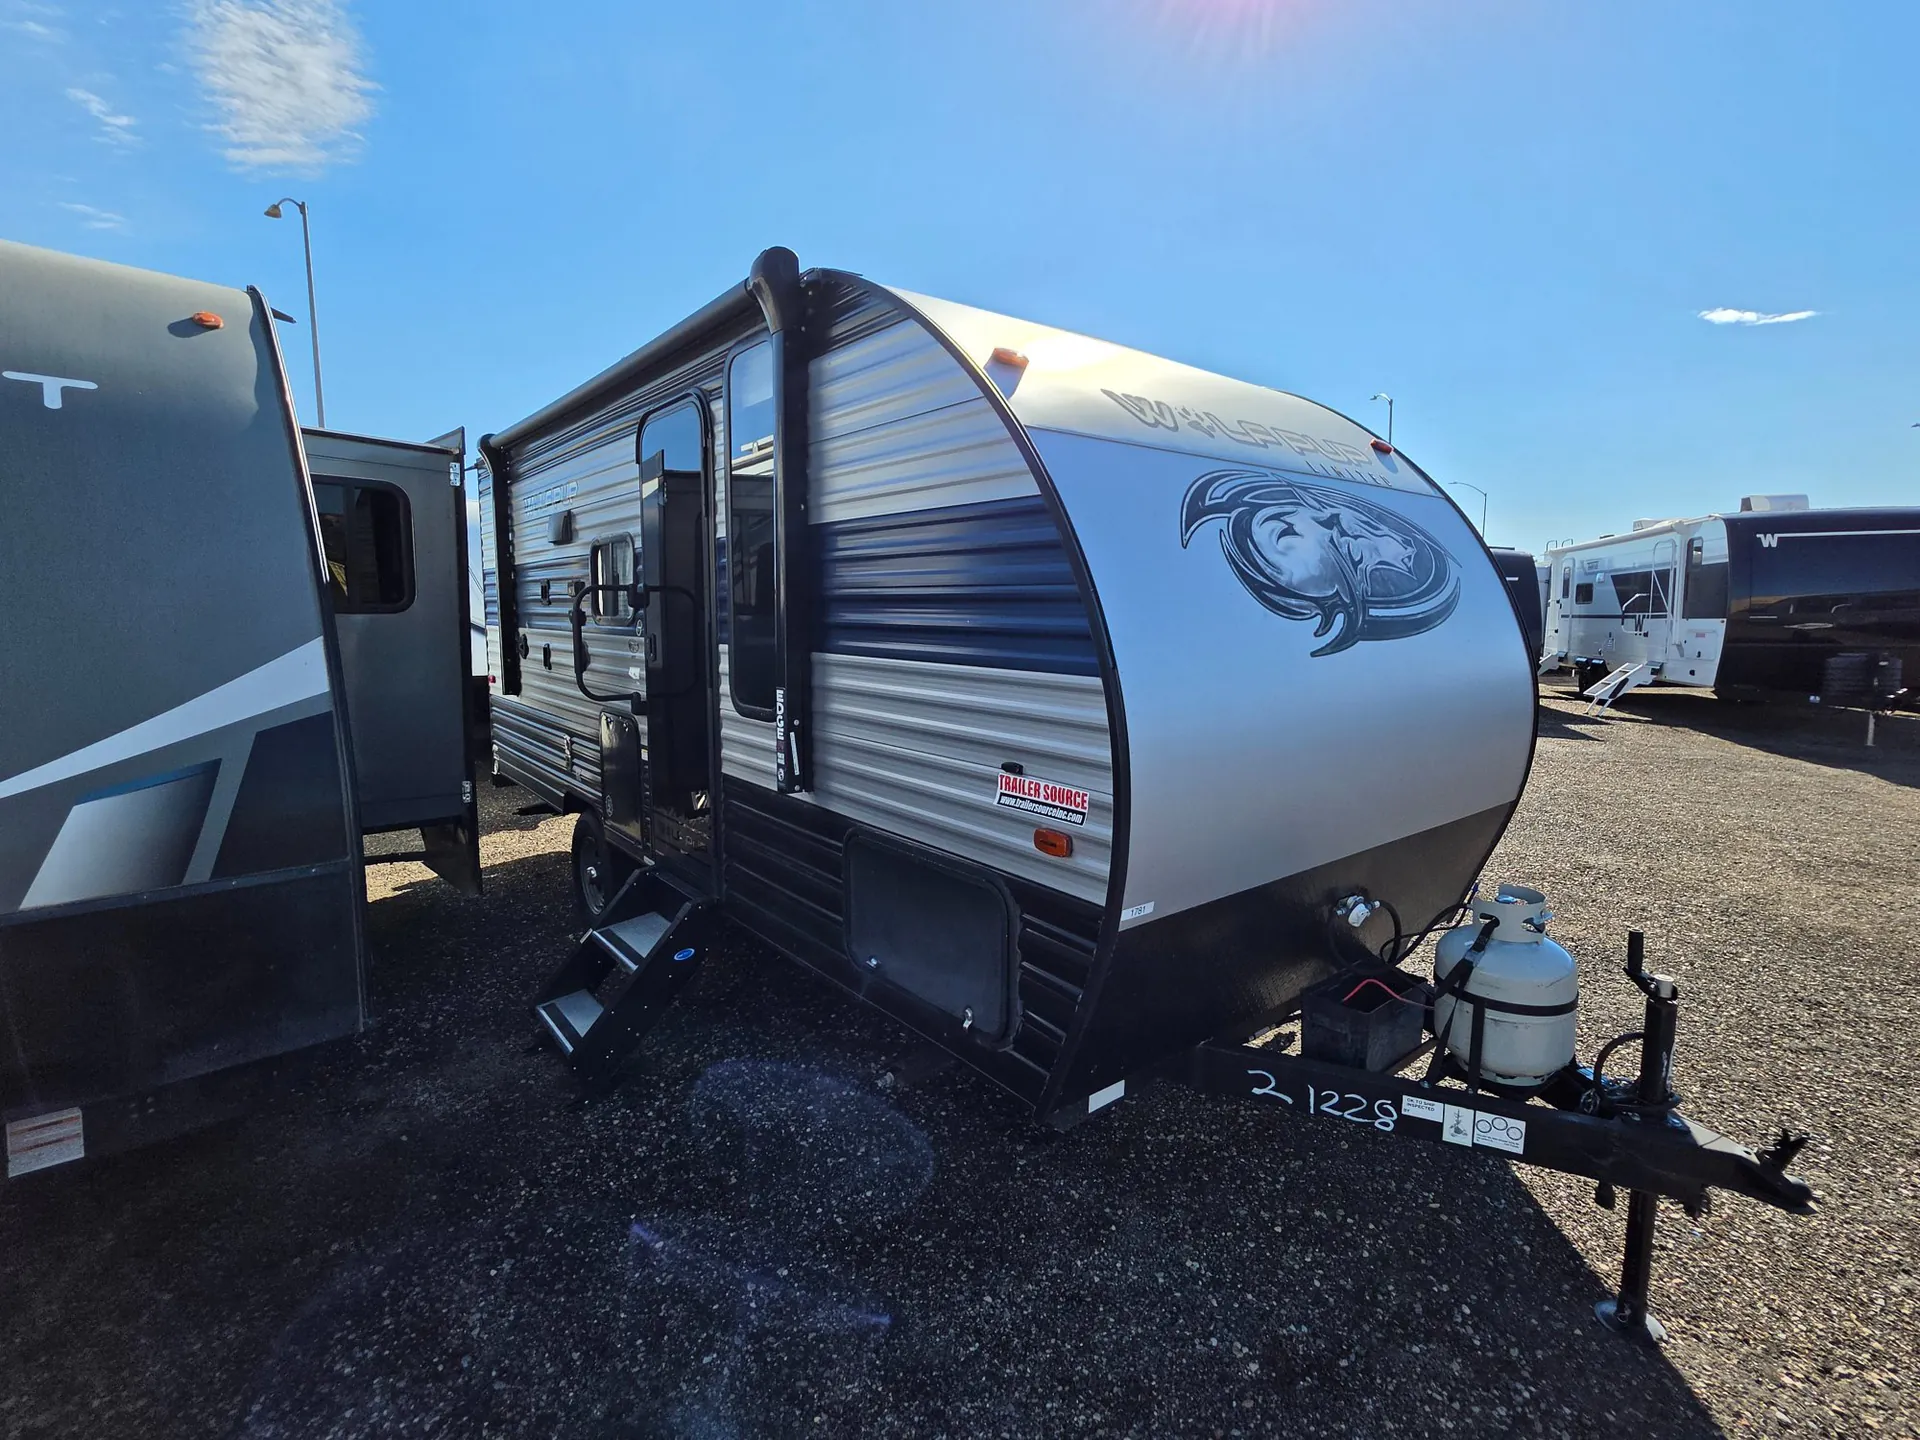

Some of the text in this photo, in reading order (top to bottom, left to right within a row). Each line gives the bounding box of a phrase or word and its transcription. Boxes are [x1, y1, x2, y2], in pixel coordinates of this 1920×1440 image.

[1305, 460, 1393, 487] LIMITED
[776, 689, 785, 741] EDGE
[999, 774, 1089, 810] TRAILER SOURCE
[1130, 905, 1146, 917] 1781
[1247, 1069, 1398, 1132] 2 1228
[1406, 1102, 1436, 1112] INSPECTED
